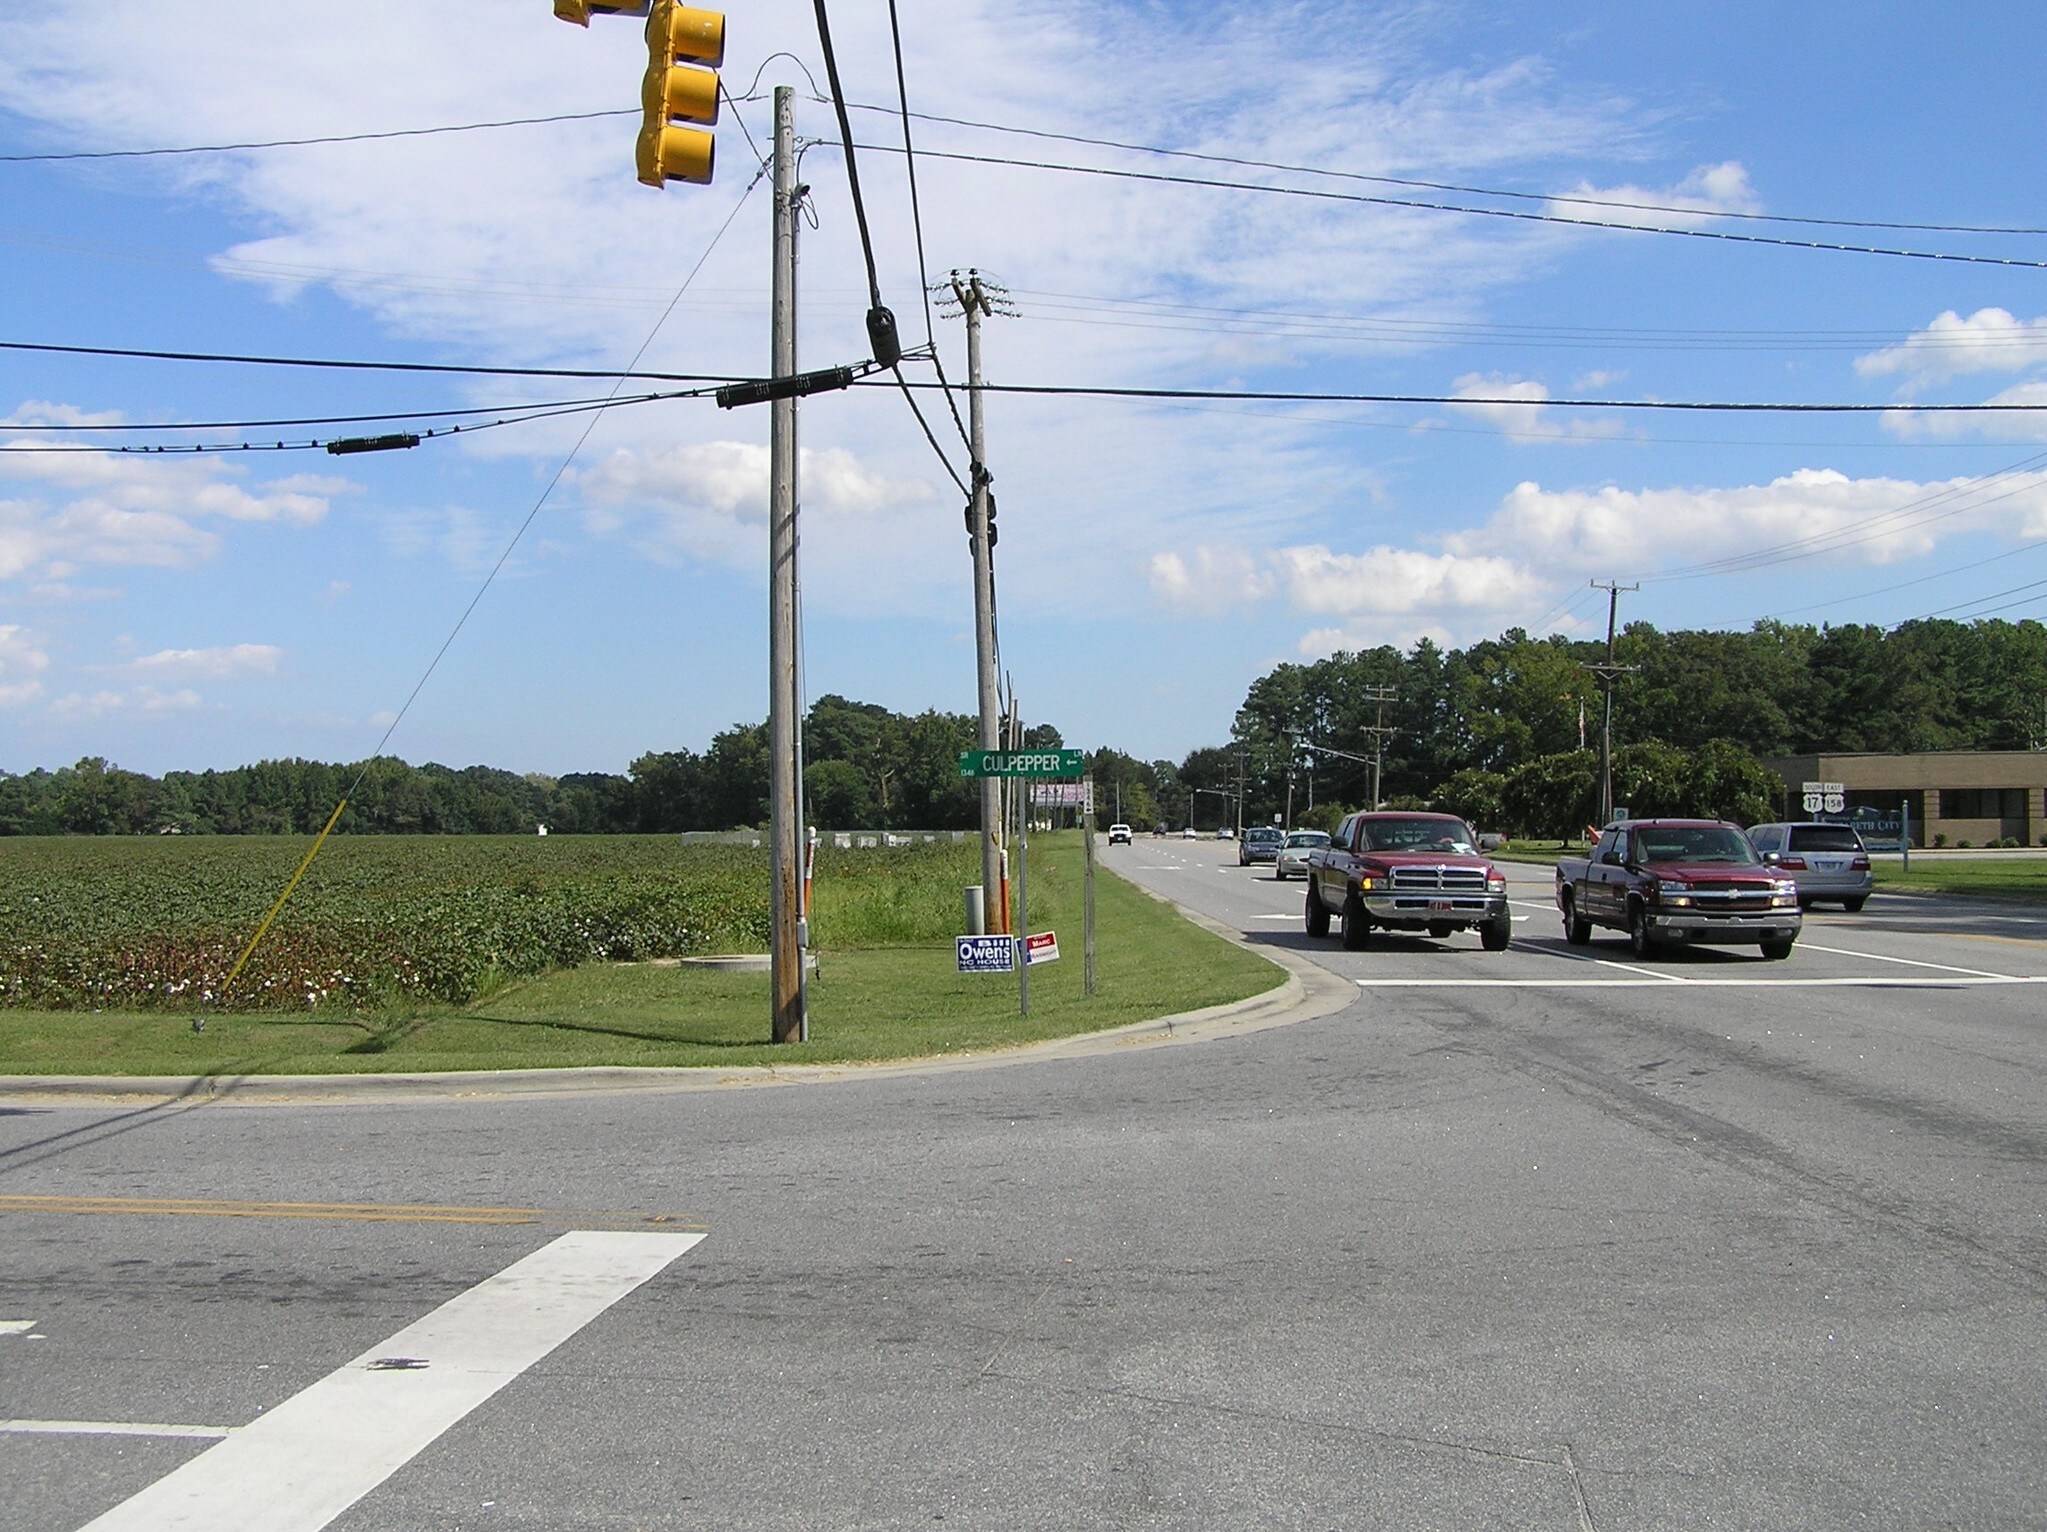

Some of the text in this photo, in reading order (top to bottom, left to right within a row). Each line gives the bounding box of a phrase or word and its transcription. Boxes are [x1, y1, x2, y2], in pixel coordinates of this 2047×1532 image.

[982, 755, 1060, 772] CULPEPPER
[1807, 797, 1819, 808] 17
[1827, 799, 1842, 808] 158
[959, 943, 1011, 960] Owens
